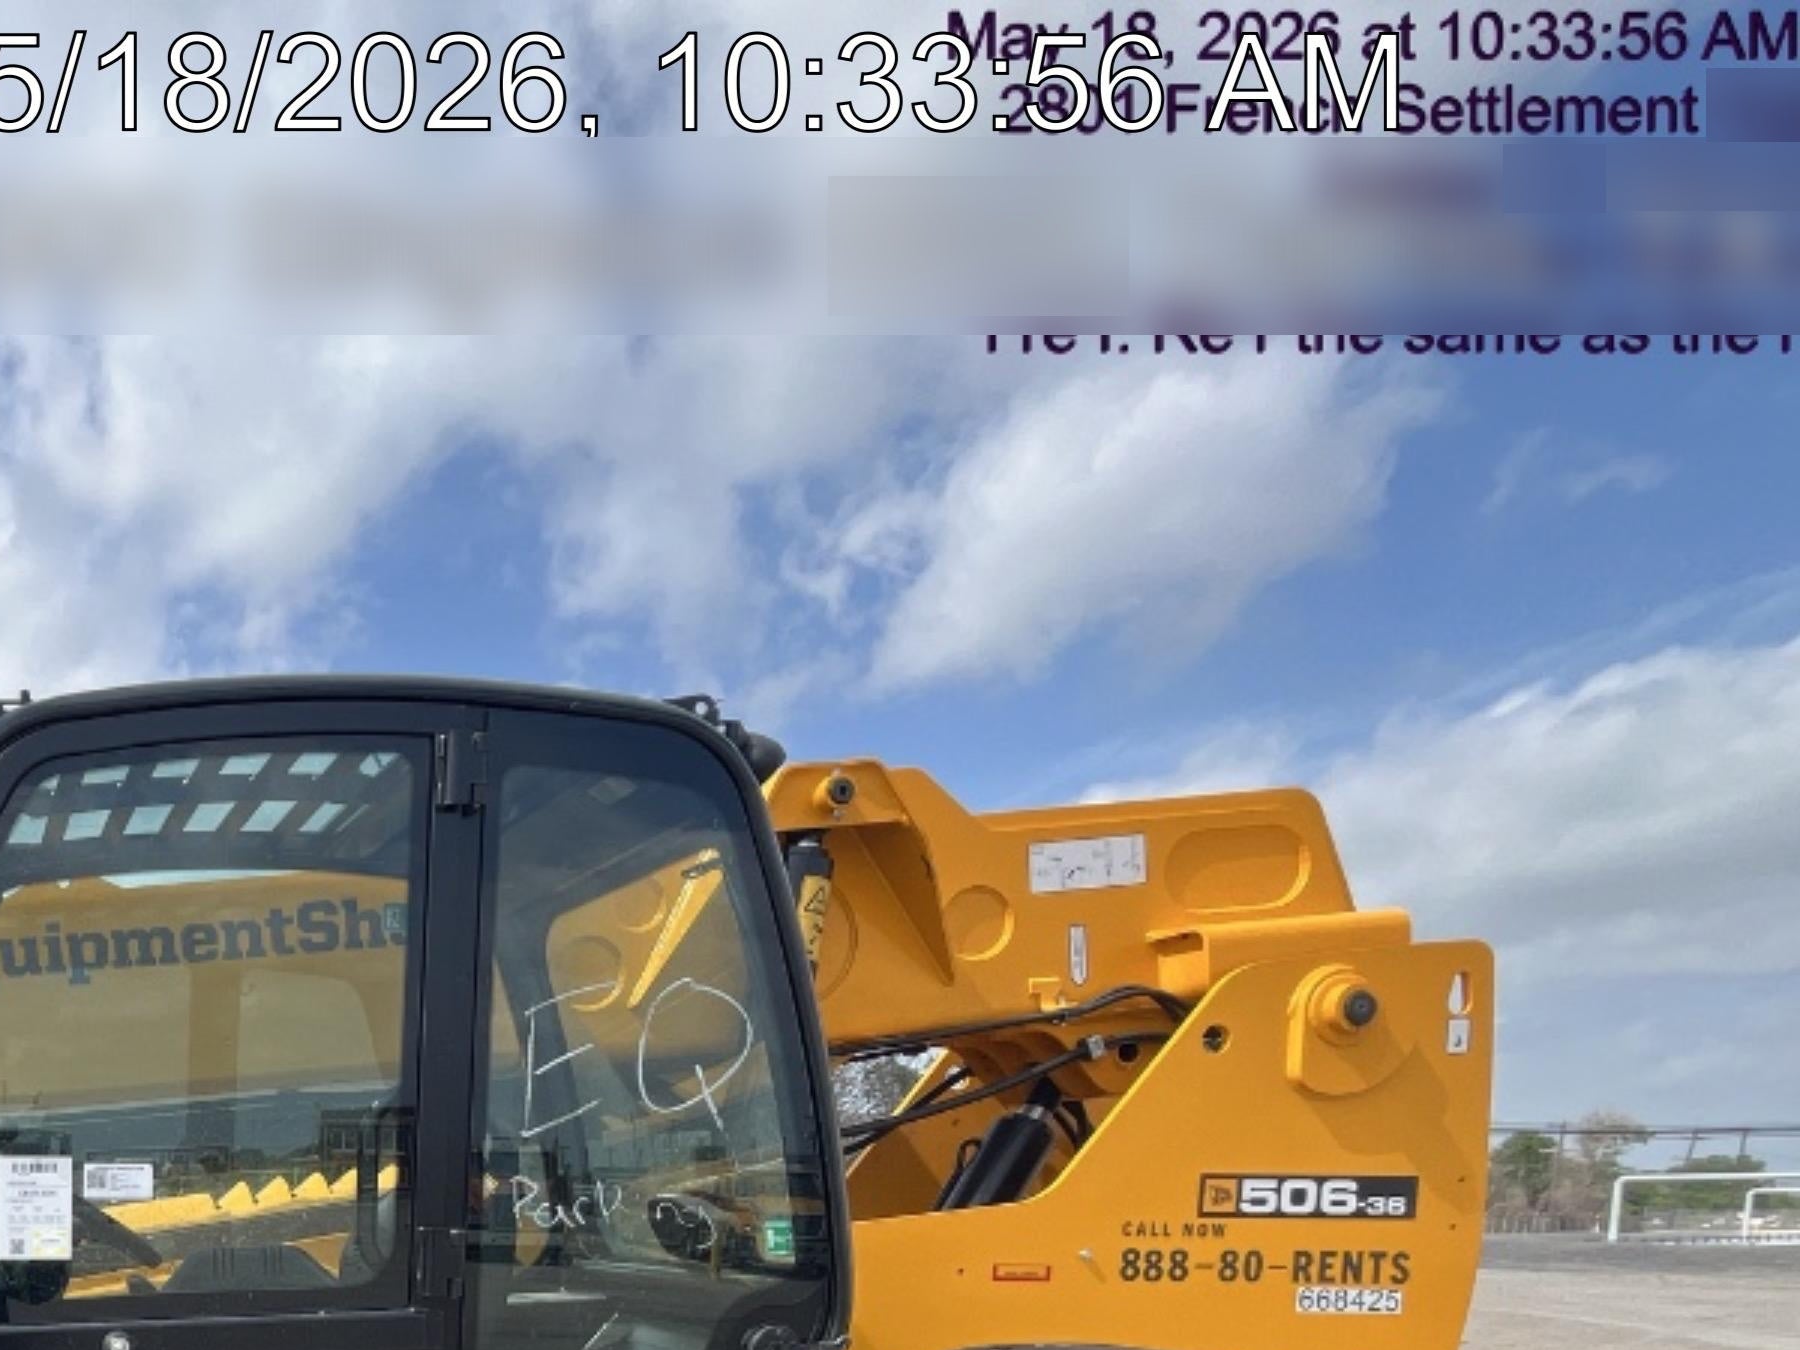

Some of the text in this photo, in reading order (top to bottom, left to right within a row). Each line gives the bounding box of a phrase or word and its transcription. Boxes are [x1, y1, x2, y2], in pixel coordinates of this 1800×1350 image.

[1121, 1221, 1227, 1238] CALL NOW
[1119, 1248, 1411, 1285] 888-80-RENTS
[1297, 1288, 1400, 1312] 668425
